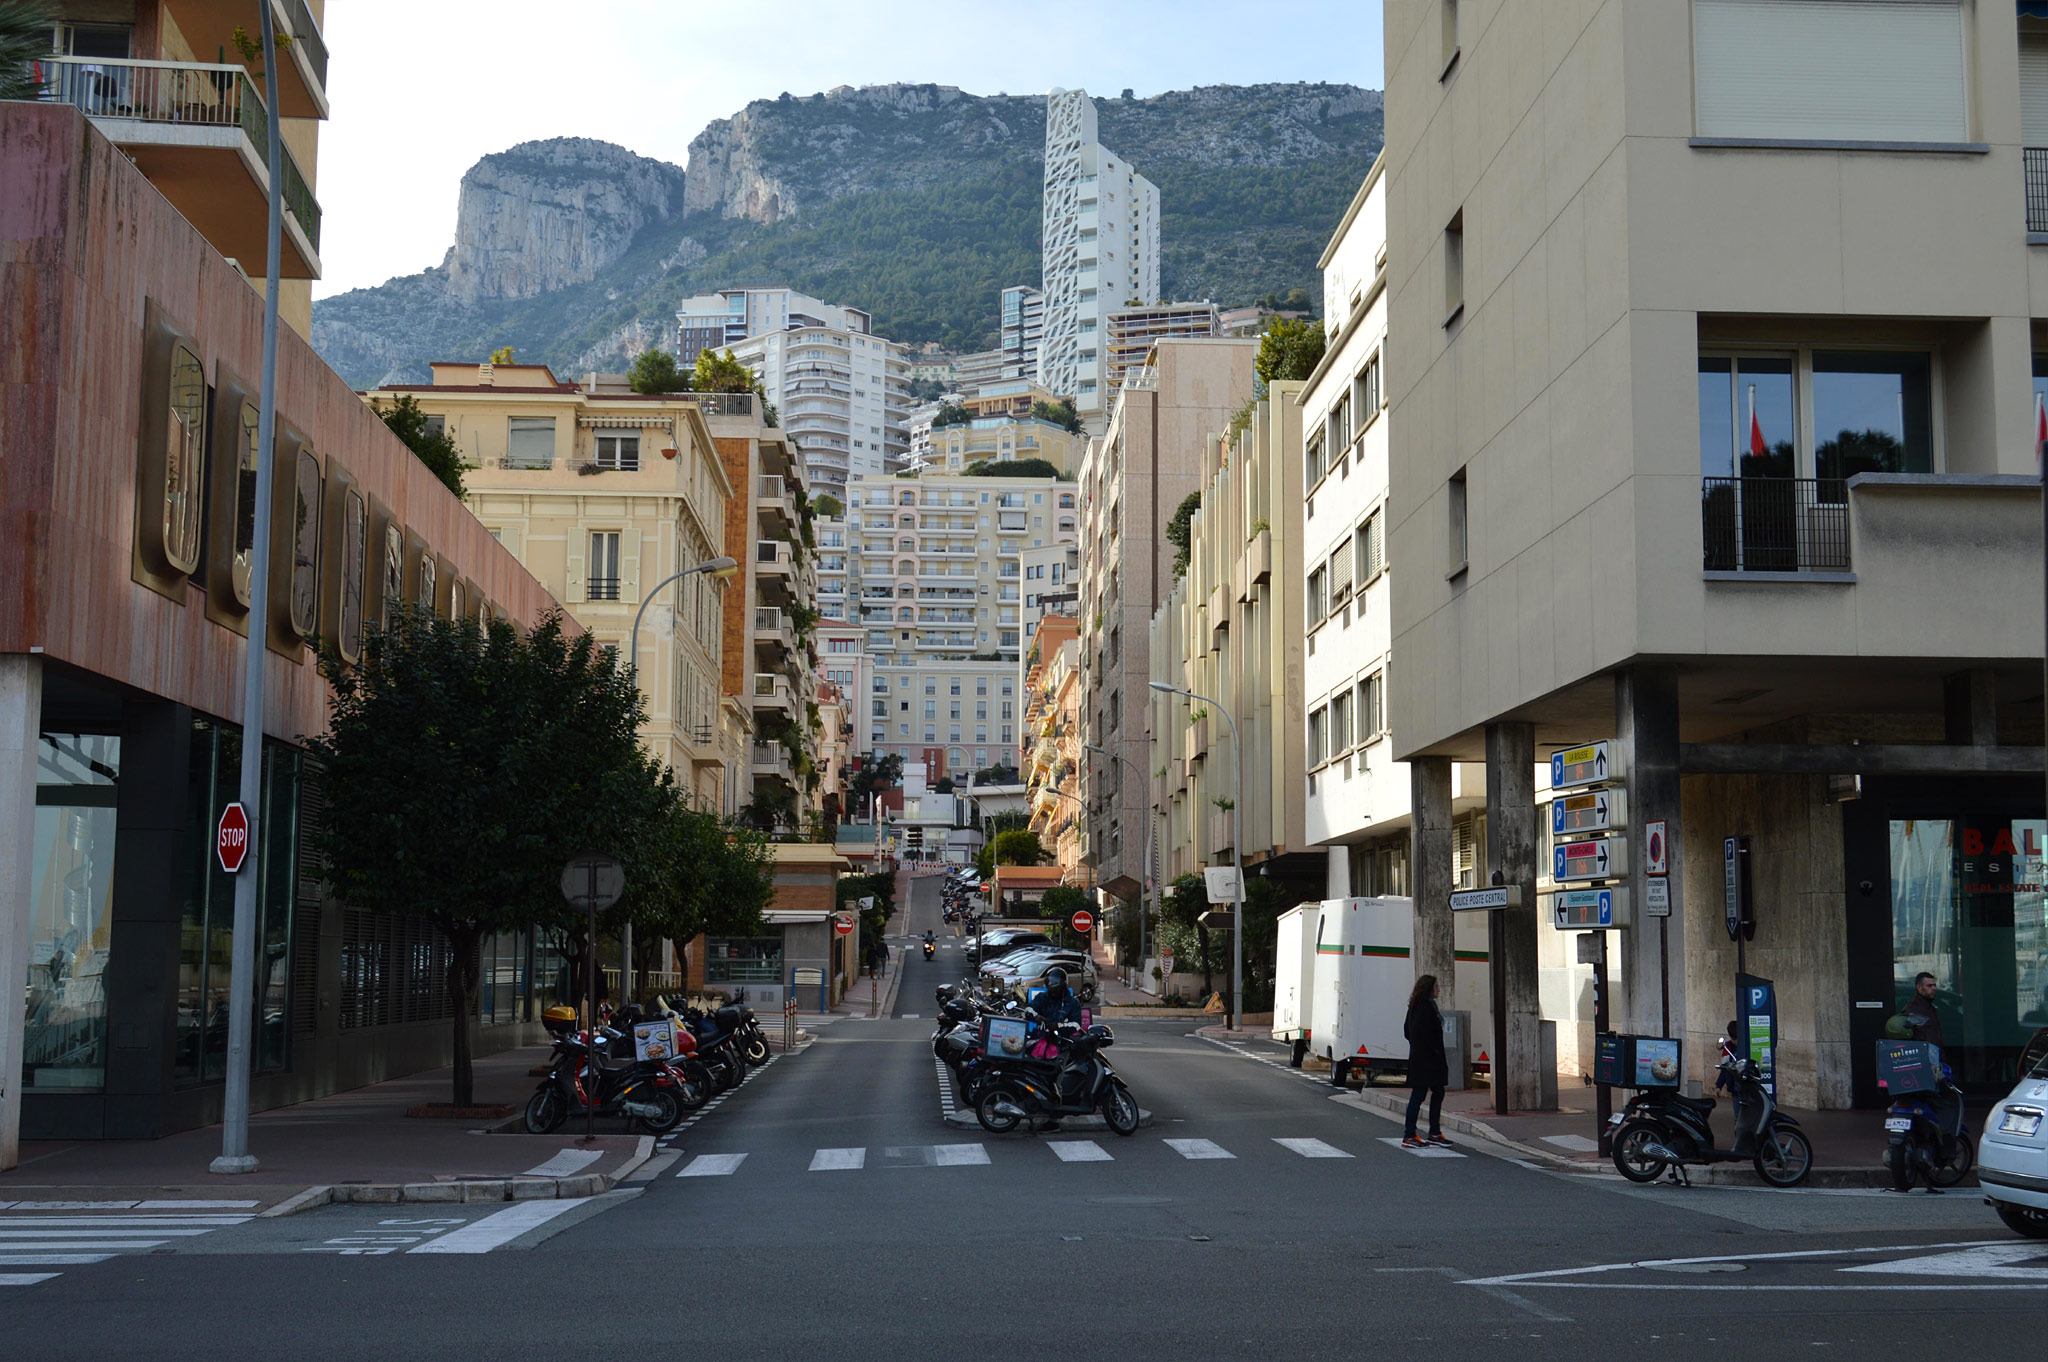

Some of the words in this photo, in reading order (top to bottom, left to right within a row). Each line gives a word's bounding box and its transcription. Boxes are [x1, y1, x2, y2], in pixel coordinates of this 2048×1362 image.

[1555, 761, 1561, 780] P
[1556, 807, 1562, 826] P
[221, 828, 245, 847] STOP
[1557, 853, 1563, 872] P
[1964, 882, 1993, 893] REAL
[2000, 882, 2040, 893] ESTATE
[1453, 895, 1469, 907] POLICE
[1470, 894, 1484, 905] POSTE
[1485, 892, 1506, 904] CENTRAL
[1601, 898, 1608, 918] P
[1751, 989, 1762, 1006] P
